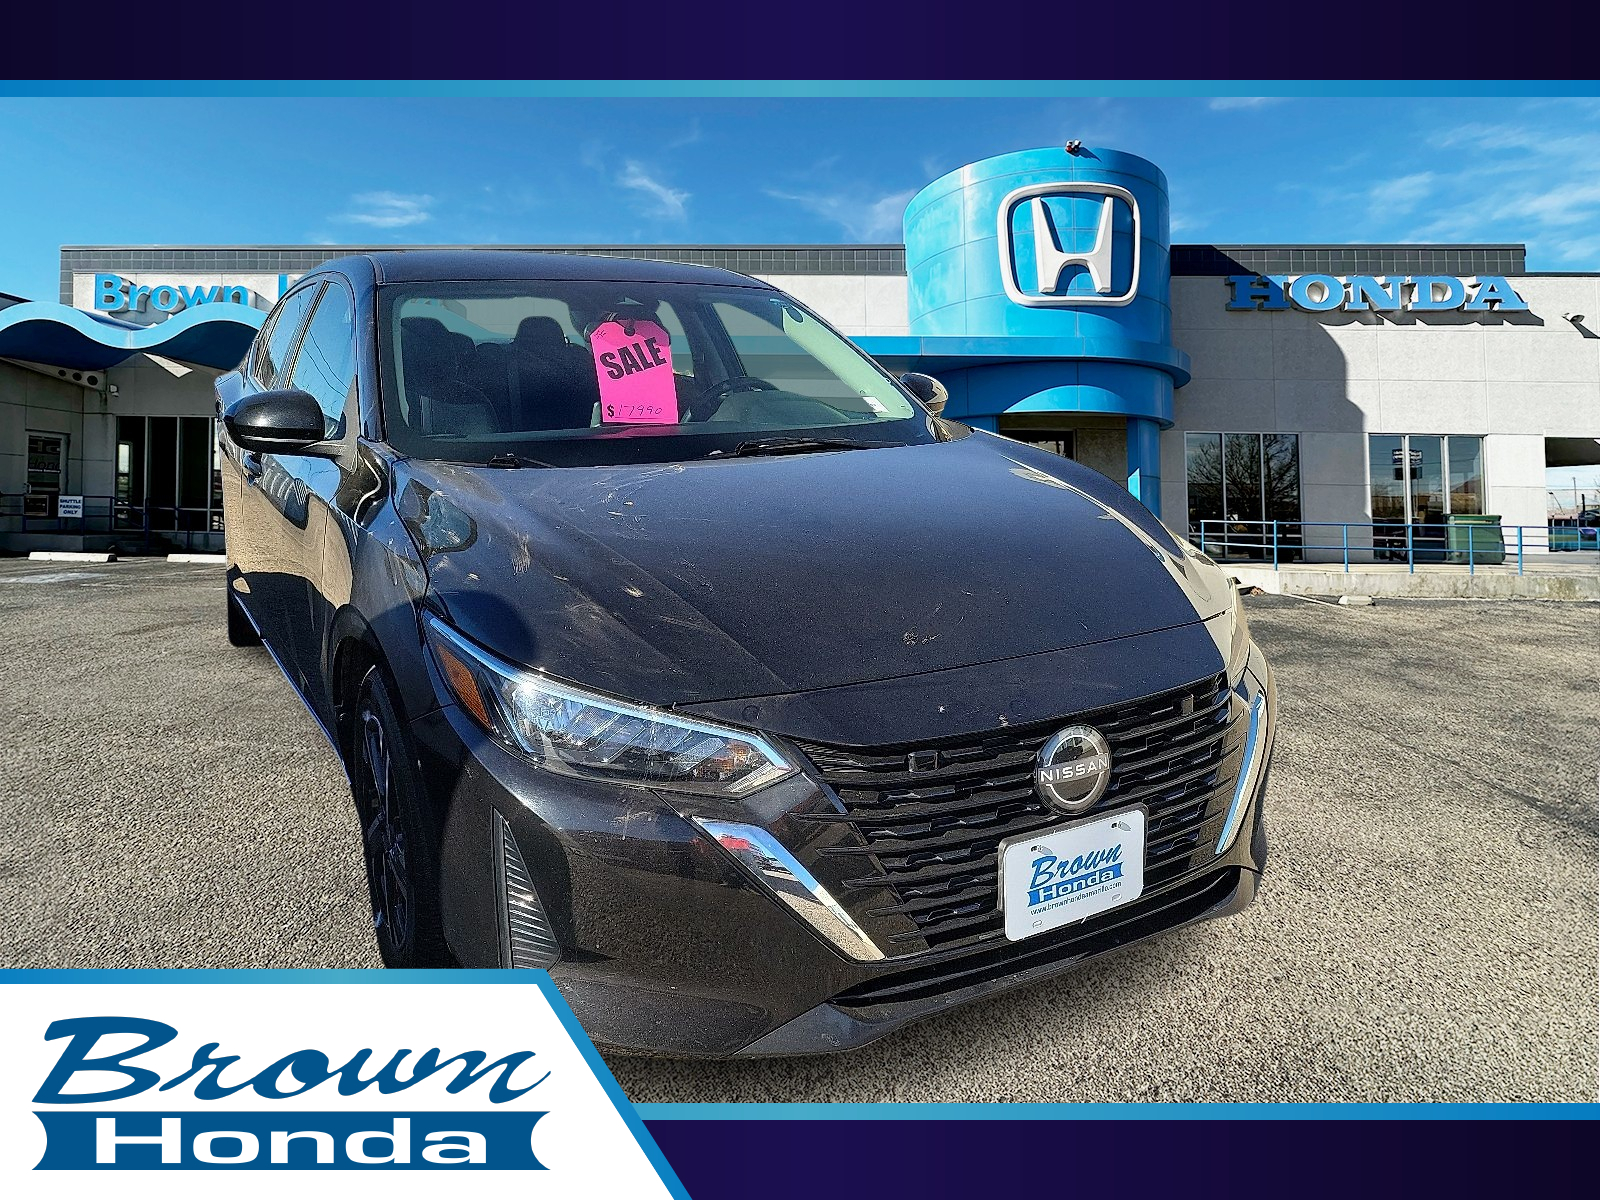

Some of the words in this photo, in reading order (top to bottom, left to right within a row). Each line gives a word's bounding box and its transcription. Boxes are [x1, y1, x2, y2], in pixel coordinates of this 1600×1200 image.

[95, 274, 248, 311] Brown
[1226, 274, 1529, 312] HONDA
[600, 337, 667, 379] SALE
[1040, 756, 1108, 783] NISSAN
[1029, 843, 1122, 890] Brown
[1038, 869, 1114, 903] Honda
